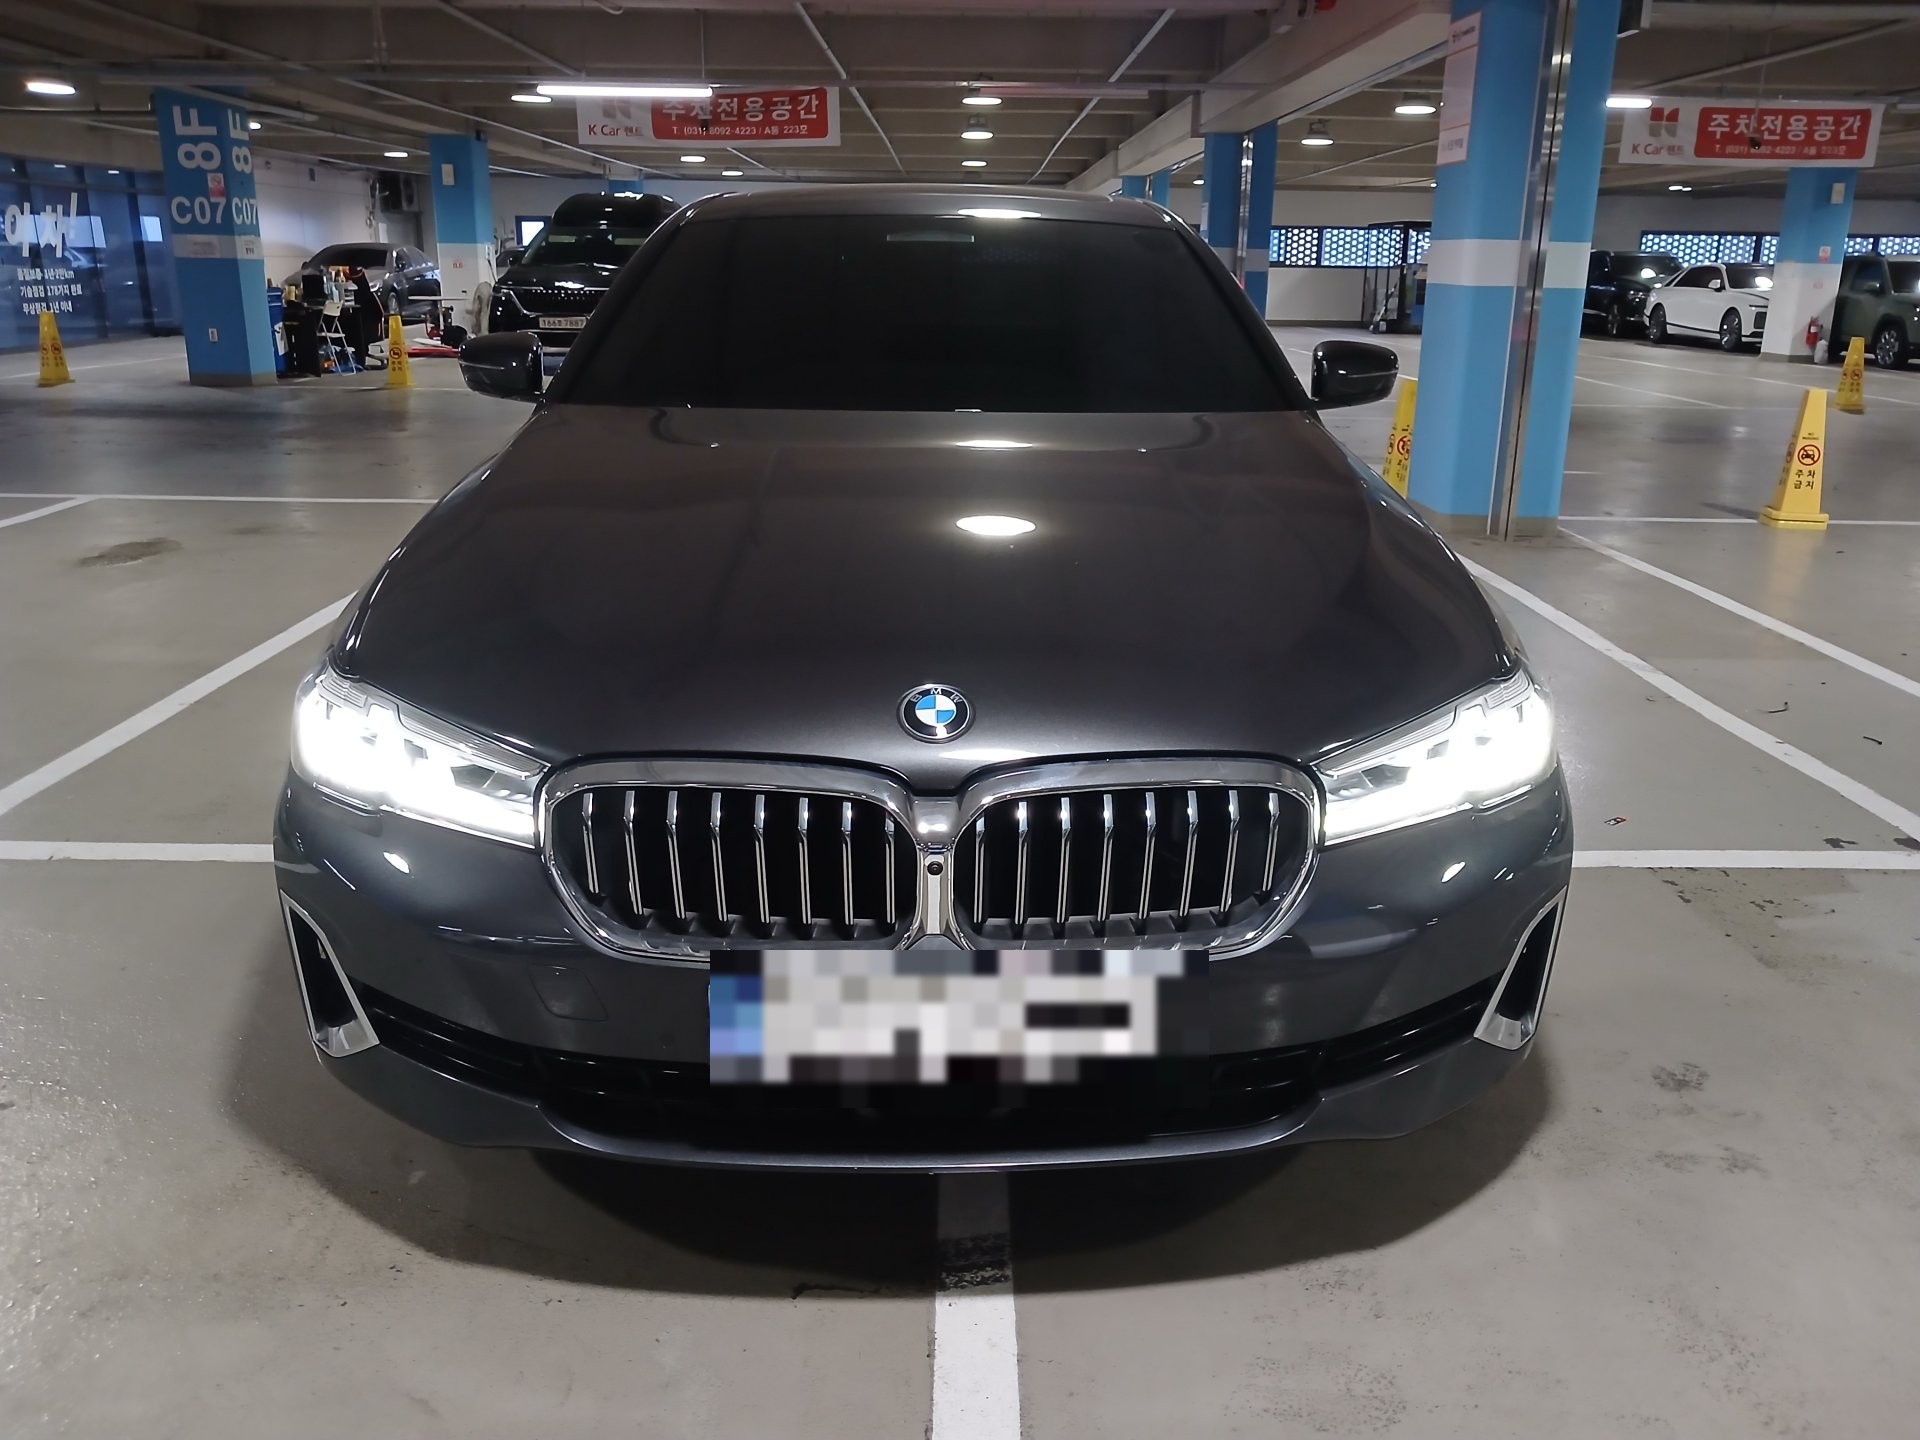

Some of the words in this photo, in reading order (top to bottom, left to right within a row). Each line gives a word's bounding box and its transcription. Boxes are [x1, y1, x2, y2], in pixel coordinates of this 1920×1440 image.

[172, 105, 221, 170] 8F
[588, 124, 597, 136] K
[601, 125, 620, 137] Car
[1708, 114, 1862, 141] 주차전용공간
[228, 109, 252, 174] 8F
[1632, 143, 1641, 155] K
[1644, 143, 1664, 155] Car
[171, 196, 227, 224] C07
[232, 197, 258, 225] C07
[910, 687, 963, 703] BMW
